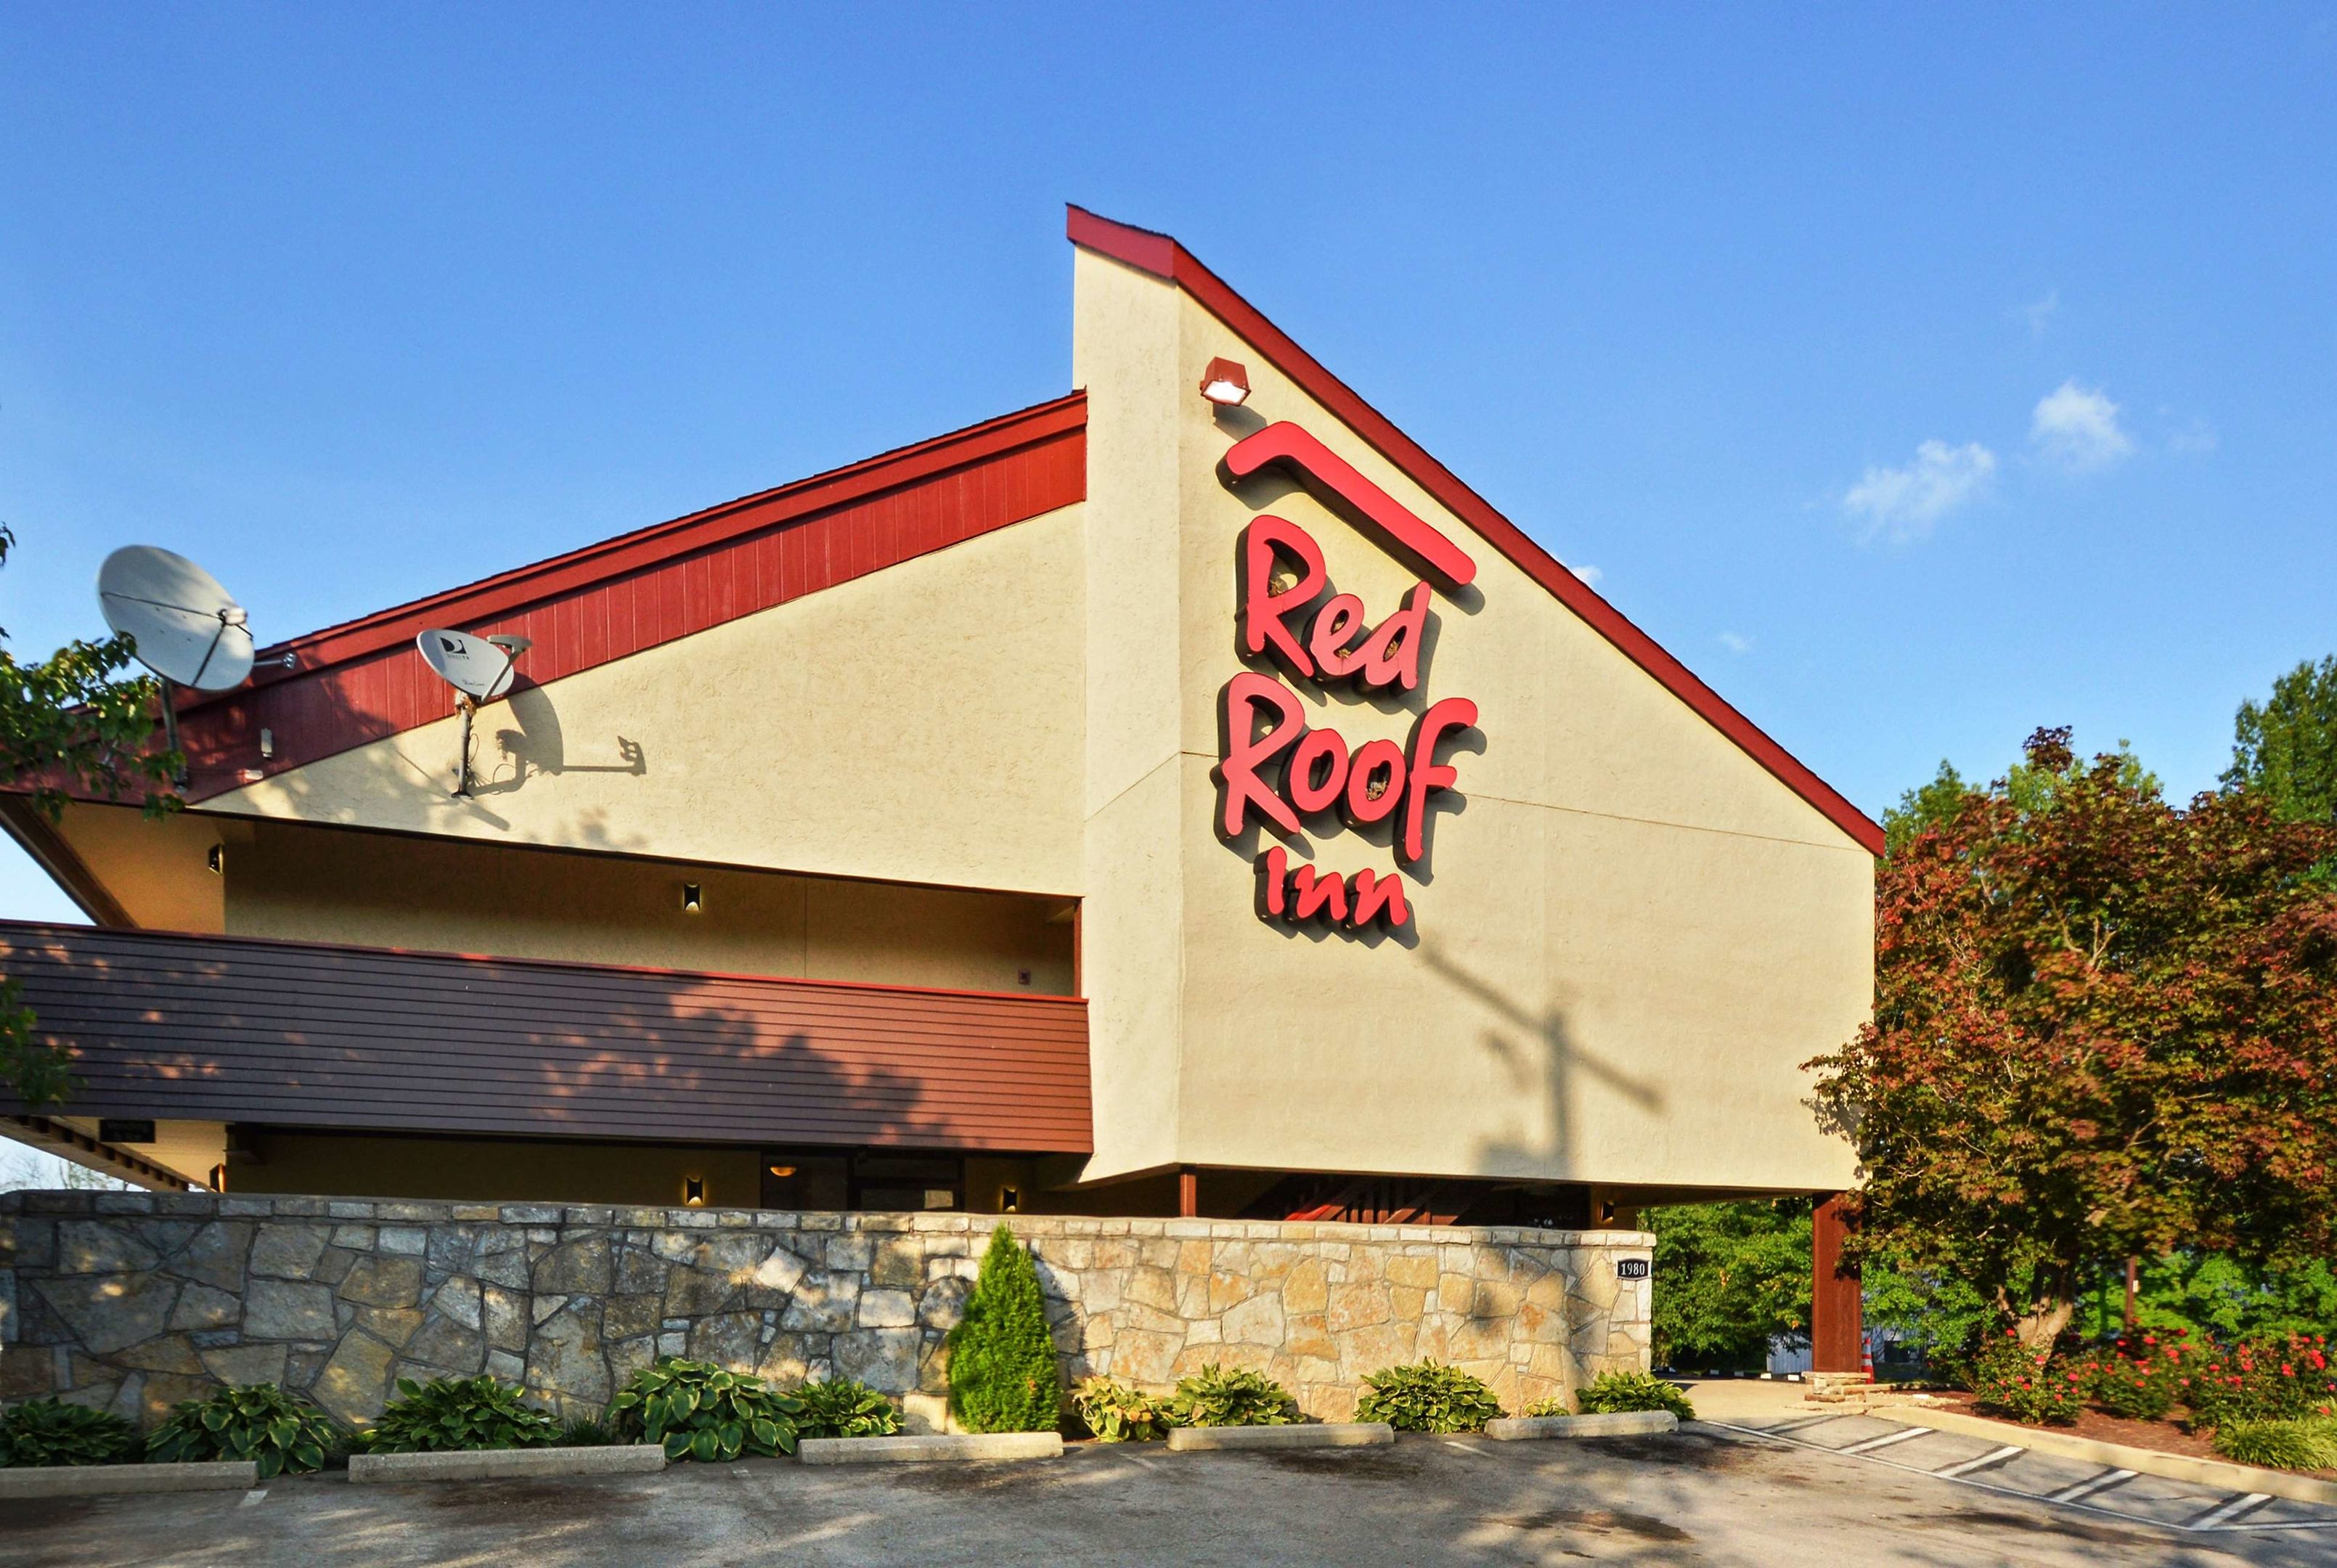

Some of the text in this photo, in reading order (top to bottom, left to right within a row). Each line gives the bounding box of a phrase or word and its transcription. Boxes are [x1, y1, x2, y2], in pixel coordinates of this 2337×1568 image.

[1245, 515, 1432, 690] Red
[1221, 672, 1479, 862] Roof
[1621, 1263, 1645, 1275] 1980
